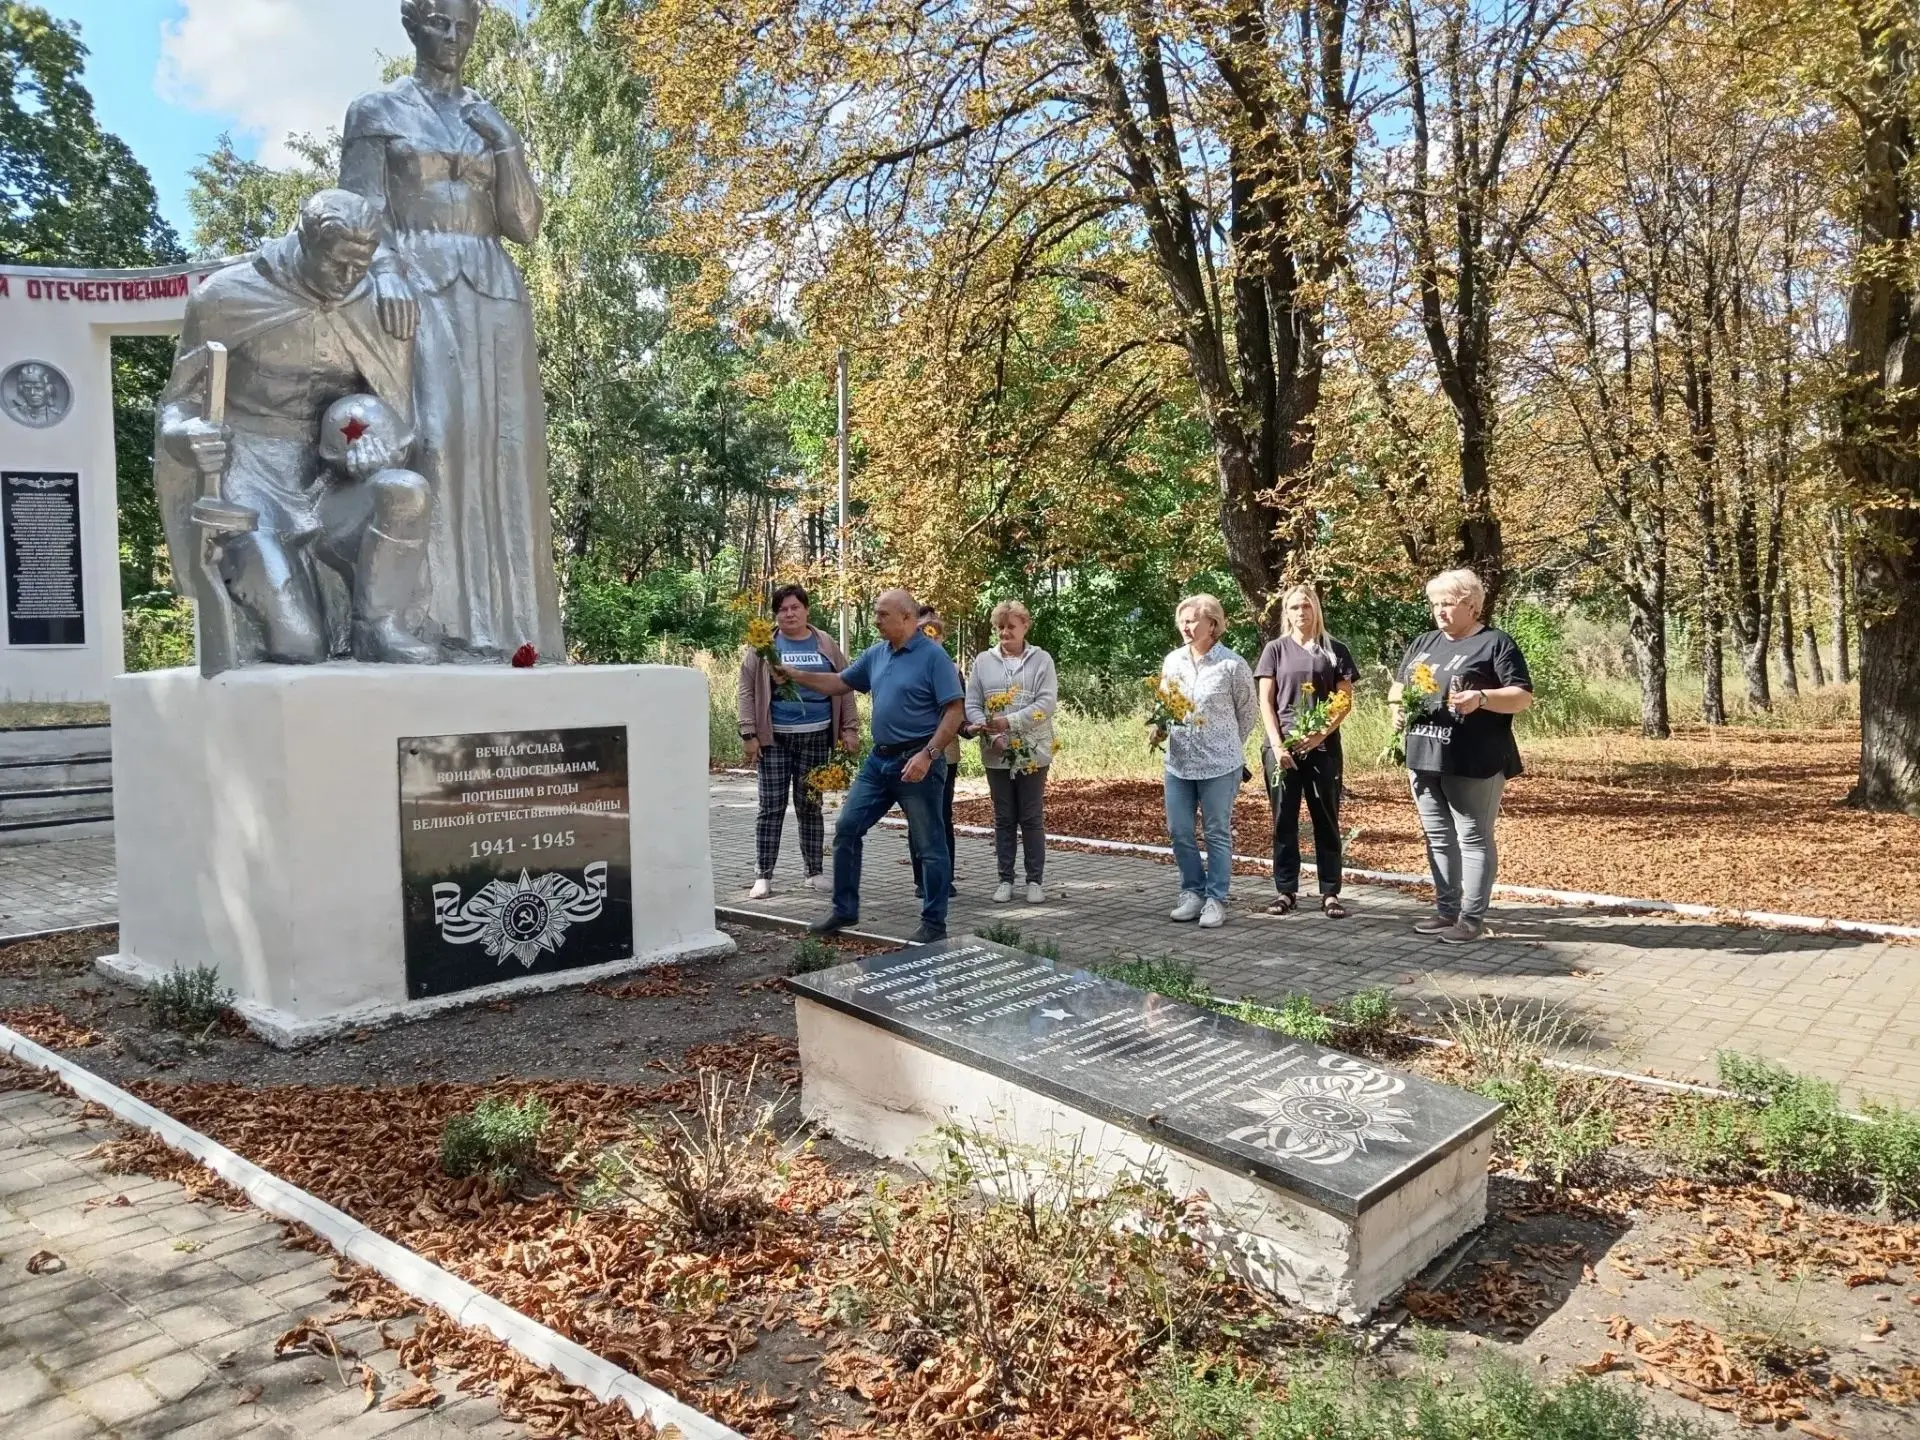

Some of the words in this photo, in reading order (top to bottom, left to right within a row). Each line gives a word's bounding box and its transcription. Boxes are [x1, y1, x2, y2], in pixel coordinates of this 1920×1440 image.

[27, 274, 189, 301] ОТЕЧЕСТВЕННОЙ
[783, 654, 820, 663] LUXURY
[475, 745, 525, 758] ВЕЧНАЯ
[527, 743, 564, 755] СЛАВА
[437, 760, 599, 783] ВОИНАМ-ОДНОСЕЛЬЧАНАМ,
[462, 787, 534, 803] ПОГИБШИМ
[537, 786, 545, 797] В
[547, 783, 579, 795] ГОДЫ
[413, 811, 475, 830] ВЕЛИКОЙ
[478, 802, 579, 824] ОТЕЧЕСТВЕННОЙ
[580, 799, 621, 812] ВОЙНЫ
[469, 837, 515, 858] 1941
[532, 830, 576, 850] 1945
[832, 971, 886, 987] ЗДЕСЬ
[883, 945, 984, 973] ПОХОРОНЕНЫ
[858, 974, 921, 994] ВОИНЫ
[919, 952, 1003, 977] СОВЕТСКОЙ
[895, 998, 935, 1012] ПРИ
[933, 965, 1052, 1001] ОСВОБОЖДЕНИИ
[922, 1005, 968, 1020] СЕЛА
[963, 973, 1073, 1007] ЗЛАТОУСТОВКА
[936, 1024, 952, 1032] 9
[962, 1014, 986, 1024] 10
[983, 991, 1061, 1017] СЕНТЯБРЯ
[1057, 981, 1094, 995] 1943
